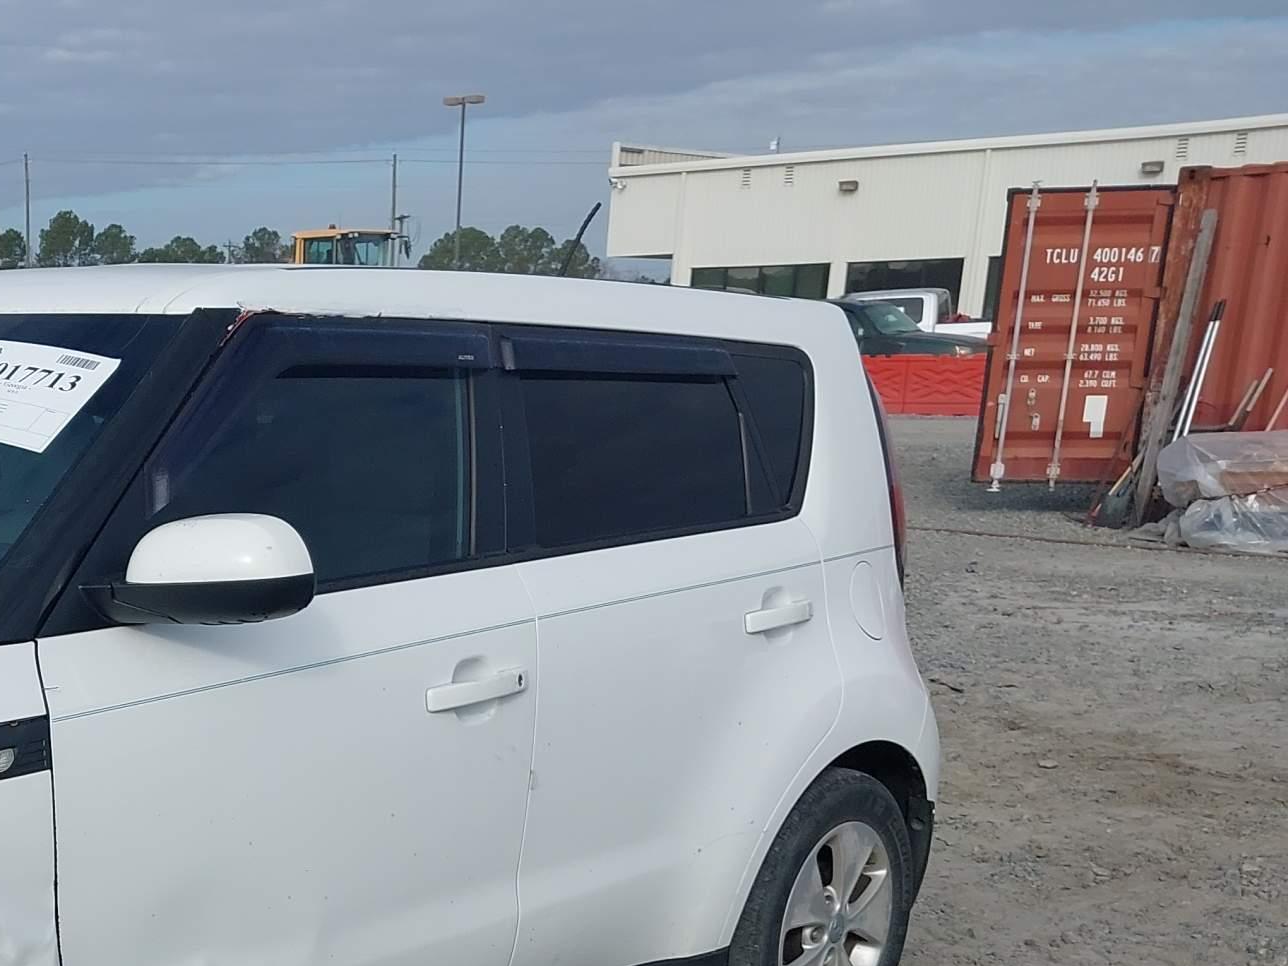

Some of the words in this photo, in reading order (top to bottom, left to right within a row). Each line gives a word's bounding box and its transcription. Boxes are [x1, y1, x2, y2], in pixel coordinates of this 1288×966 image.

[1045, 248, 1079, 264] TCLU
[1092, 247, 1144, 263] 400146
[1149, 246, 1161, 263] 7
[1090, 267, 1124, 282] 42G1
